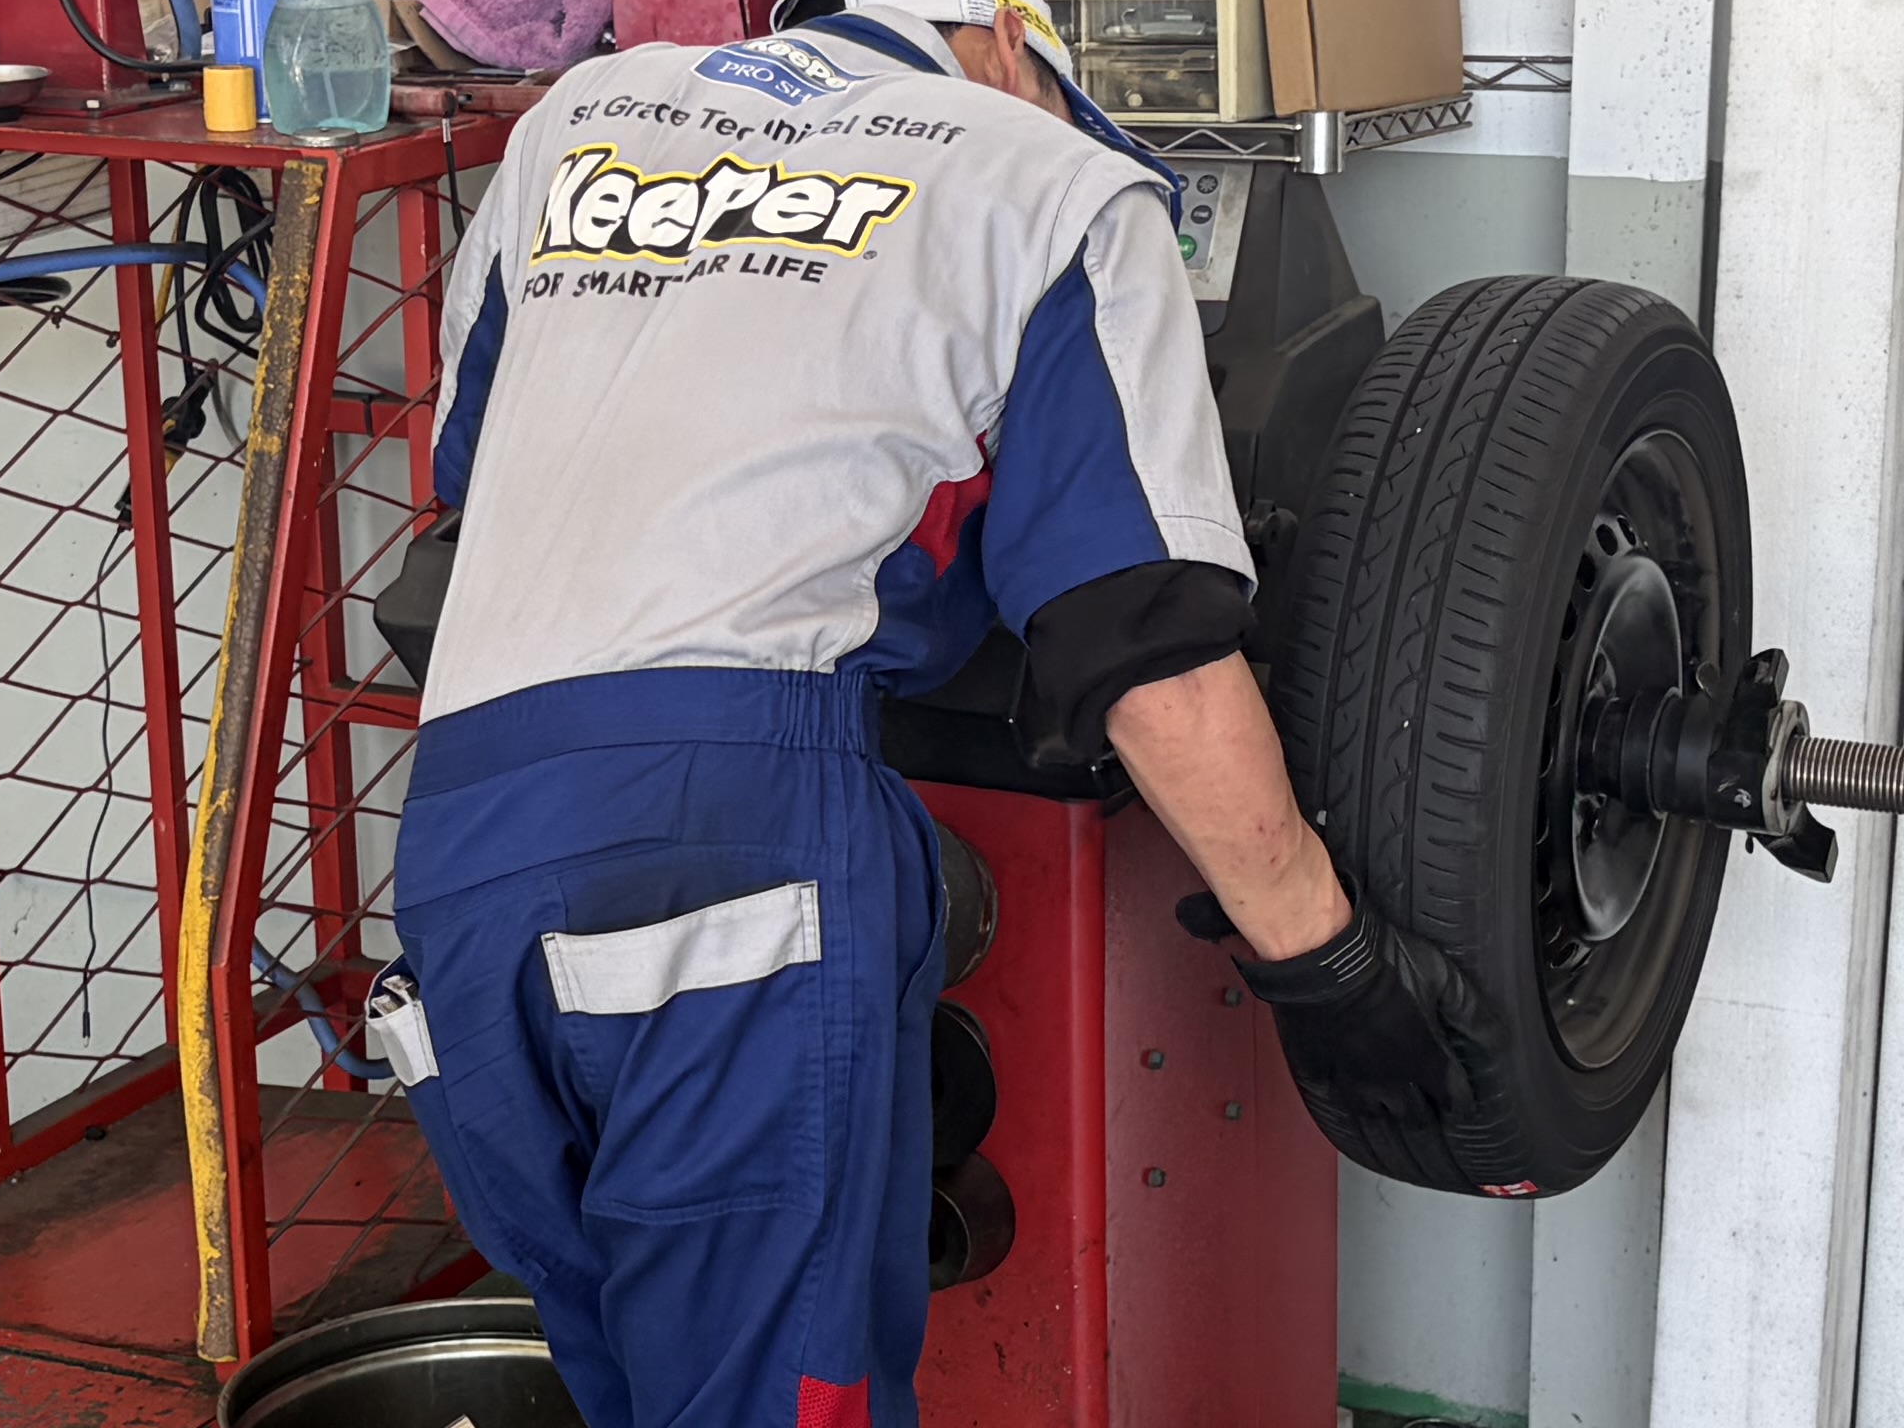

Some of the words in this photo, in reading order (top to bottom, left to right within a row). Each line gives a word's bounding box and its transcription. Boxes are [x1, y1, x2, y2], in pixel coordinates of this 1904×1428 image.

[717, 60, 775, 83] PRO
[775, 80, 814, 103] SH
[743, 40, 850, 90] KeePe
[864, 114, 967, 145] Staff
[530, 144, 915, 264] KeePer
[521, 271, 565, 305] FOR
[572, 268, 672, 298] SMART
[739, 252, 829, 284] LIFE
